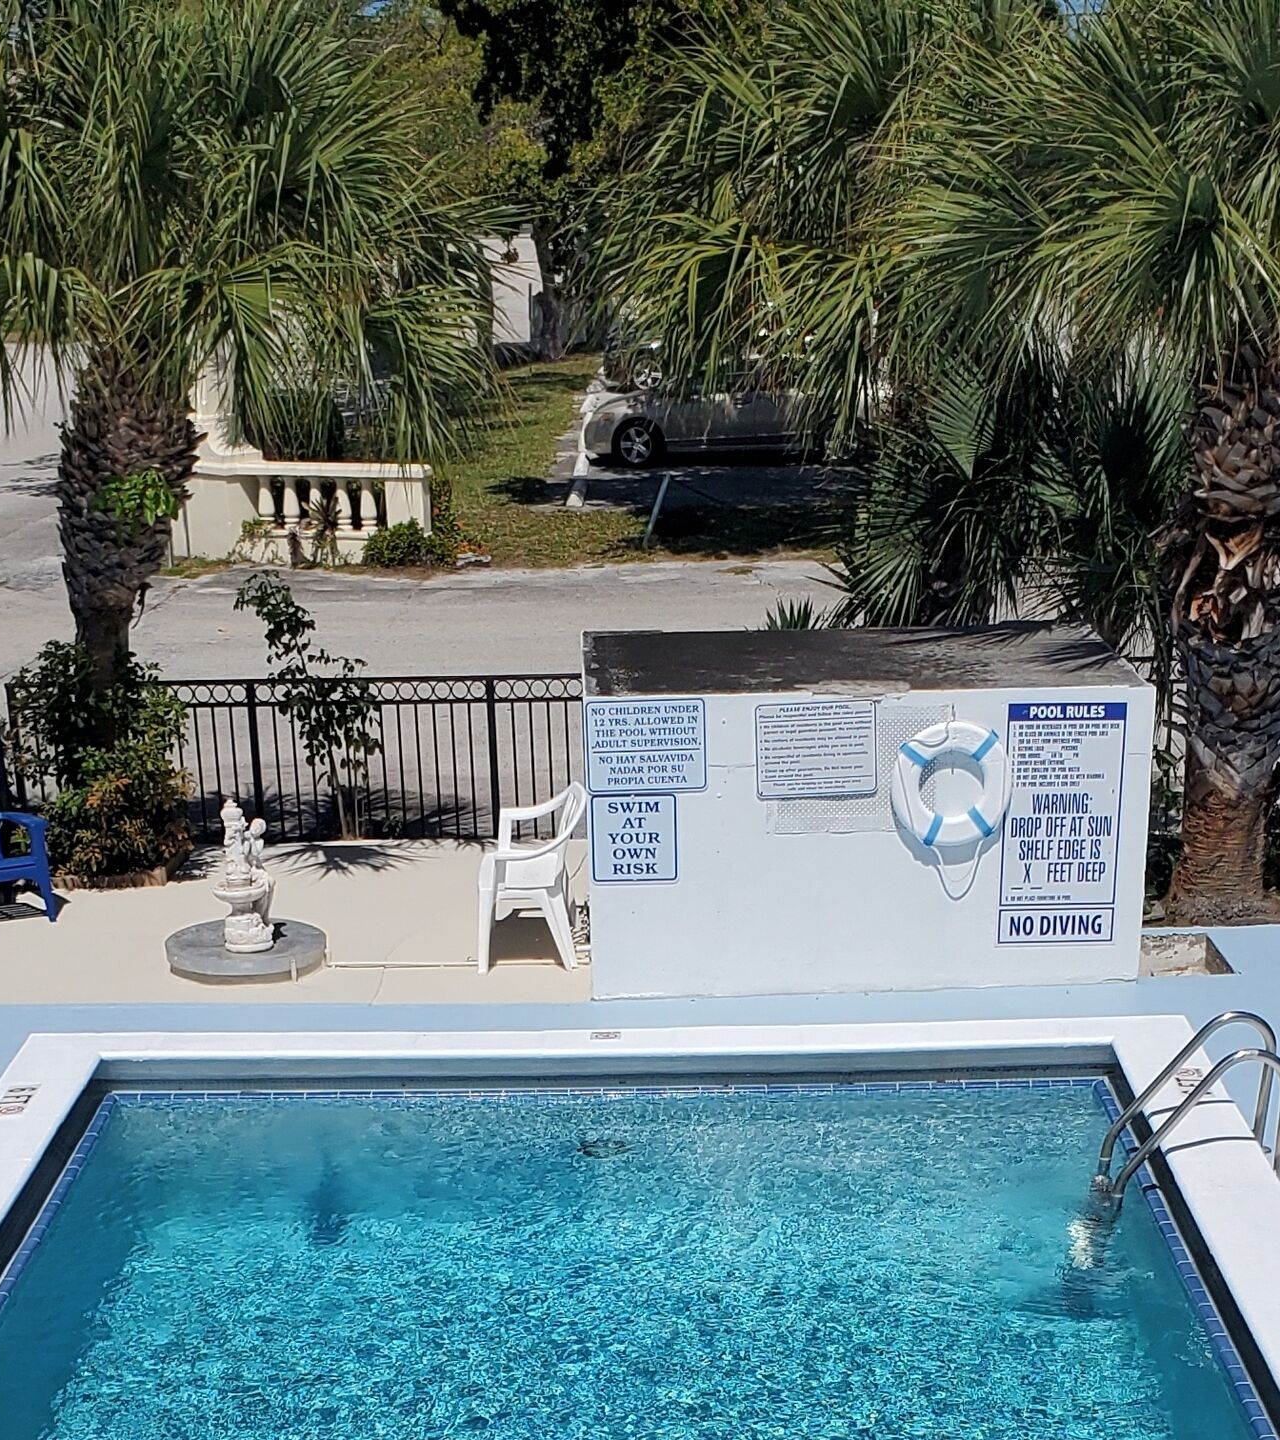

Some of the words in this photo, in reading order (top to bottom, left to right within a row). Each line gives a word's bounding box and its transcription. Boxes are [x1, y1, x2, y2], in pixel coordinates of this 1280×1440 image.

[591, 708, 605, 716] NO
[608, 706, 661, 716] CHILDREN
[664, 705, 700, 714] UNDER
[1029, 705, 1064, 719] POOL
[1065, 705, 1106, 718] RULES
[593, 719, 605, 727] 12
[608, 718, 631, 727] YRS.
[634, 716, 684, 725] ALLOWED
[687, 715, 698, 724] IN
[595, 729, 616, 738] THE
[619, 728, 646, 737] POOL
[649, 726, 697, 736] WITHOUT
[594, 739, 628, 748] ADULT
[630, 737, 701, 748] SUPERVISION.
[598, 756, 613, 764] NO
[616, 755, 637, 764] HAY
[639, 753, 695, 763] SALVAVIDA
[609, 765, 644, 775] NADAR
[647, 764, 668, 773] POR
[671, 764, 684, 772] SU
[607, 776, 645, 786] PROPIA
[647, 775, 688, 784] CUENTA
[607, 801, 660, 814] SWIM
[1032, 792, 1093, 815] WARNING:
[621, 817, 646, 829] AT
[1011, 817, 1042, 838] DROP
[1045, 816, 1067, 838] OFF
[1069, 816, 1084, 837] AT
[1087, 815, 1112, 837] SUN
[608, 832, 661, 844] YOUR
[612, 847, 657, 860] OWN
[1018, 839, 1054, 861] SHELF
[1057, 839, 1086, 860] EDGE
[1089, 838, 1101, 860] IS
[612, 863, 658, 875] RISK
[1023, 862, 1032, 884] X
[1047, 862, 1074, 883] FEET
[1077, 861, 1106, 883] DEEP
[1009, 915, 1034, 936] NO
[1040, 914, 1102, 936] DIVING
